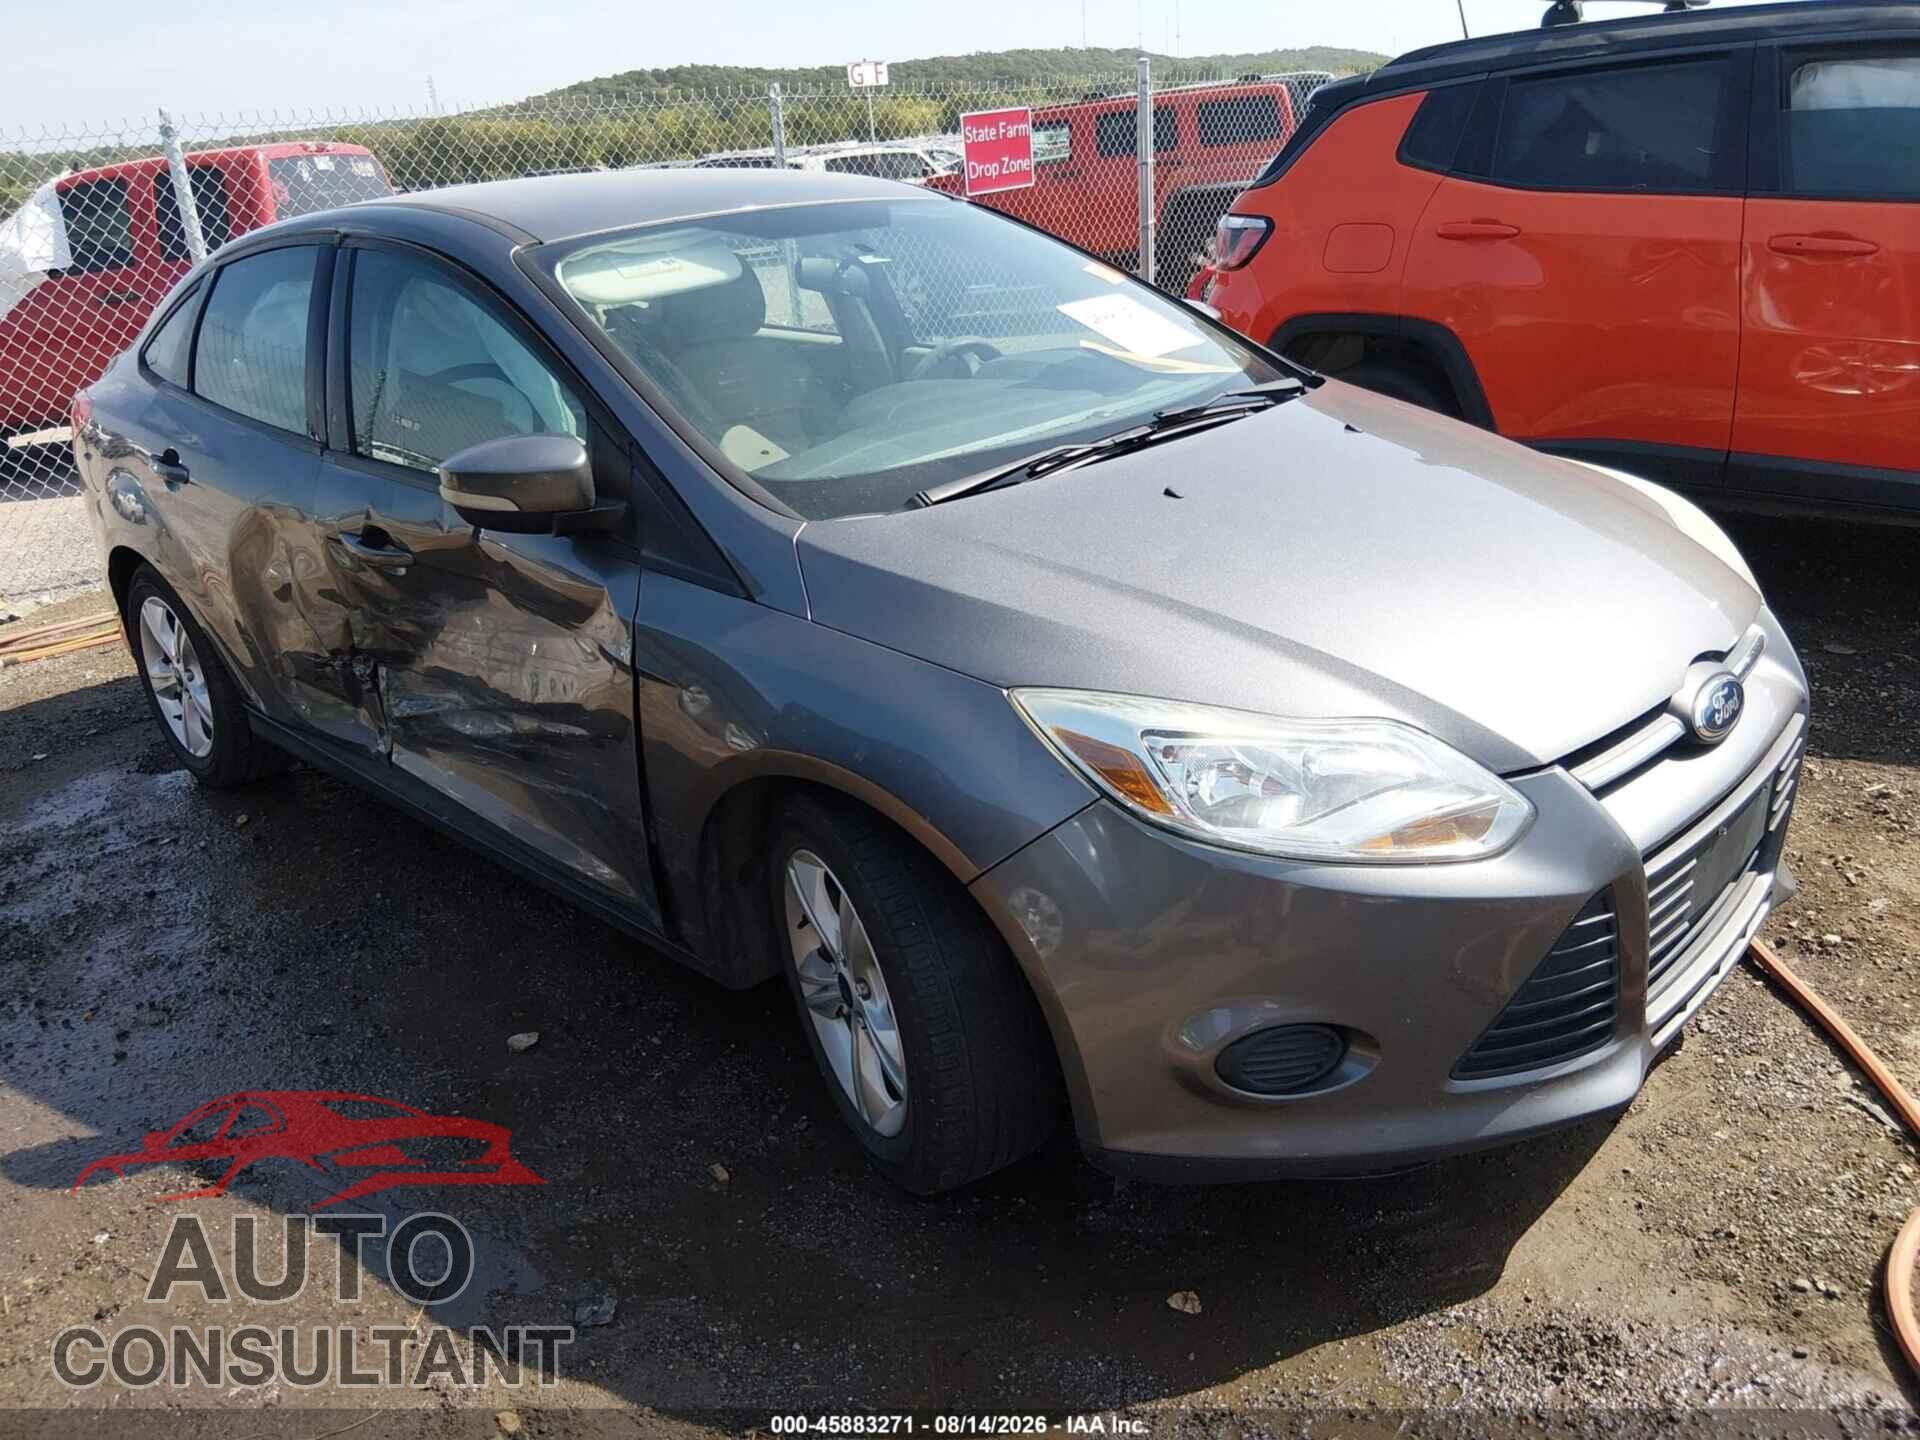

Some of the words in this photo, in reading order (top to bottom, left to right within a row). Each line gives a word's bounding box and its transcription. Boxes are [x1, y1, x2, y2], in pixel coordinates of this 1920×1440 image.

[850, 63, 864, 85] G
[874, 62, 884, 84] F
[965, 126, 996, 144] State
[999, 121, 1029, 140] Farm
[969, 160, 998, 180] Drop
[1002, 156, 1031, 174] Zone
[1712, 687, 1739, 726] Ford
